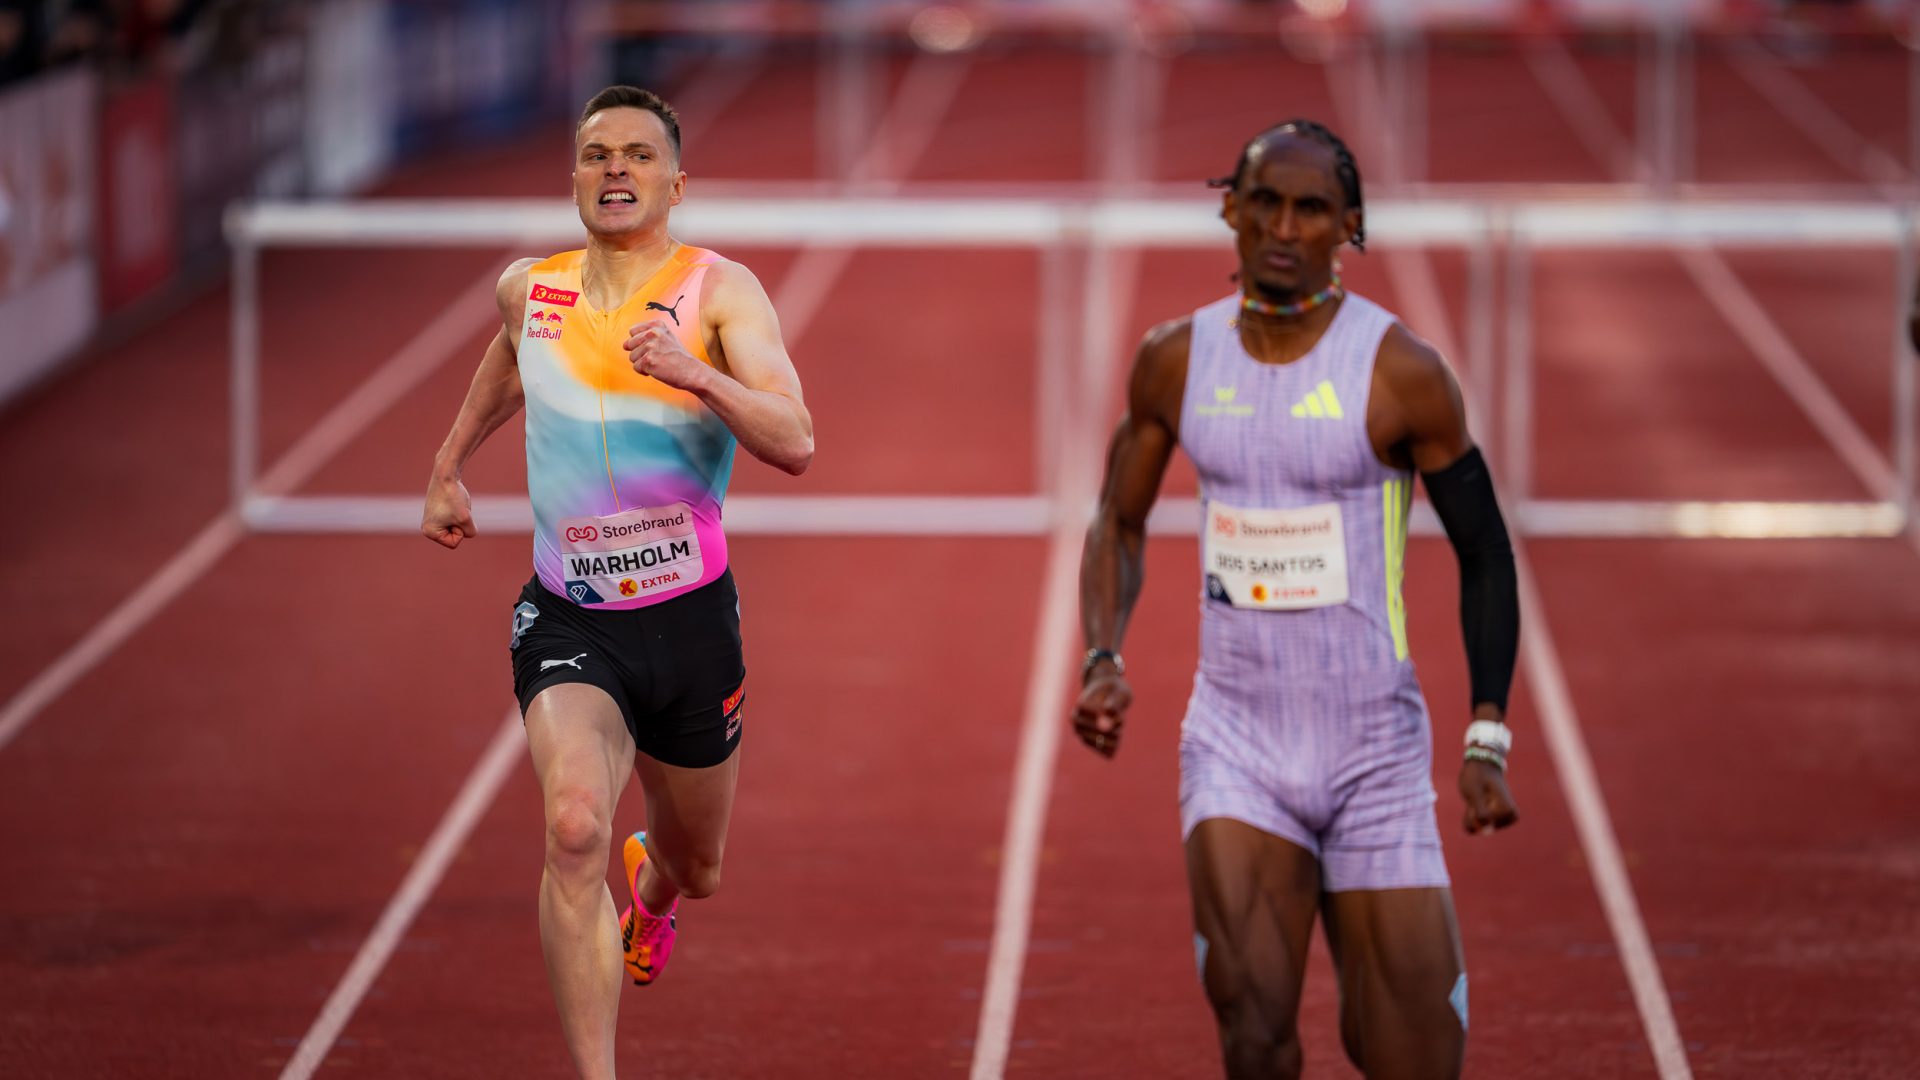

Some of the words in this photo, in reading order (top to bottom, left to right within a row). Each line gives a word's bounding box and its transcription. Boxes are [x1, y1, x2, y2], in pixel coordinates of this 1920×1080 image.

[547, 293, 573, 302] EXTRA
[602, 513, 684, 538] Storebrand
[571, 540, 690, 576] WARHOLM
[641, 572, 680, 589] EXTRA
